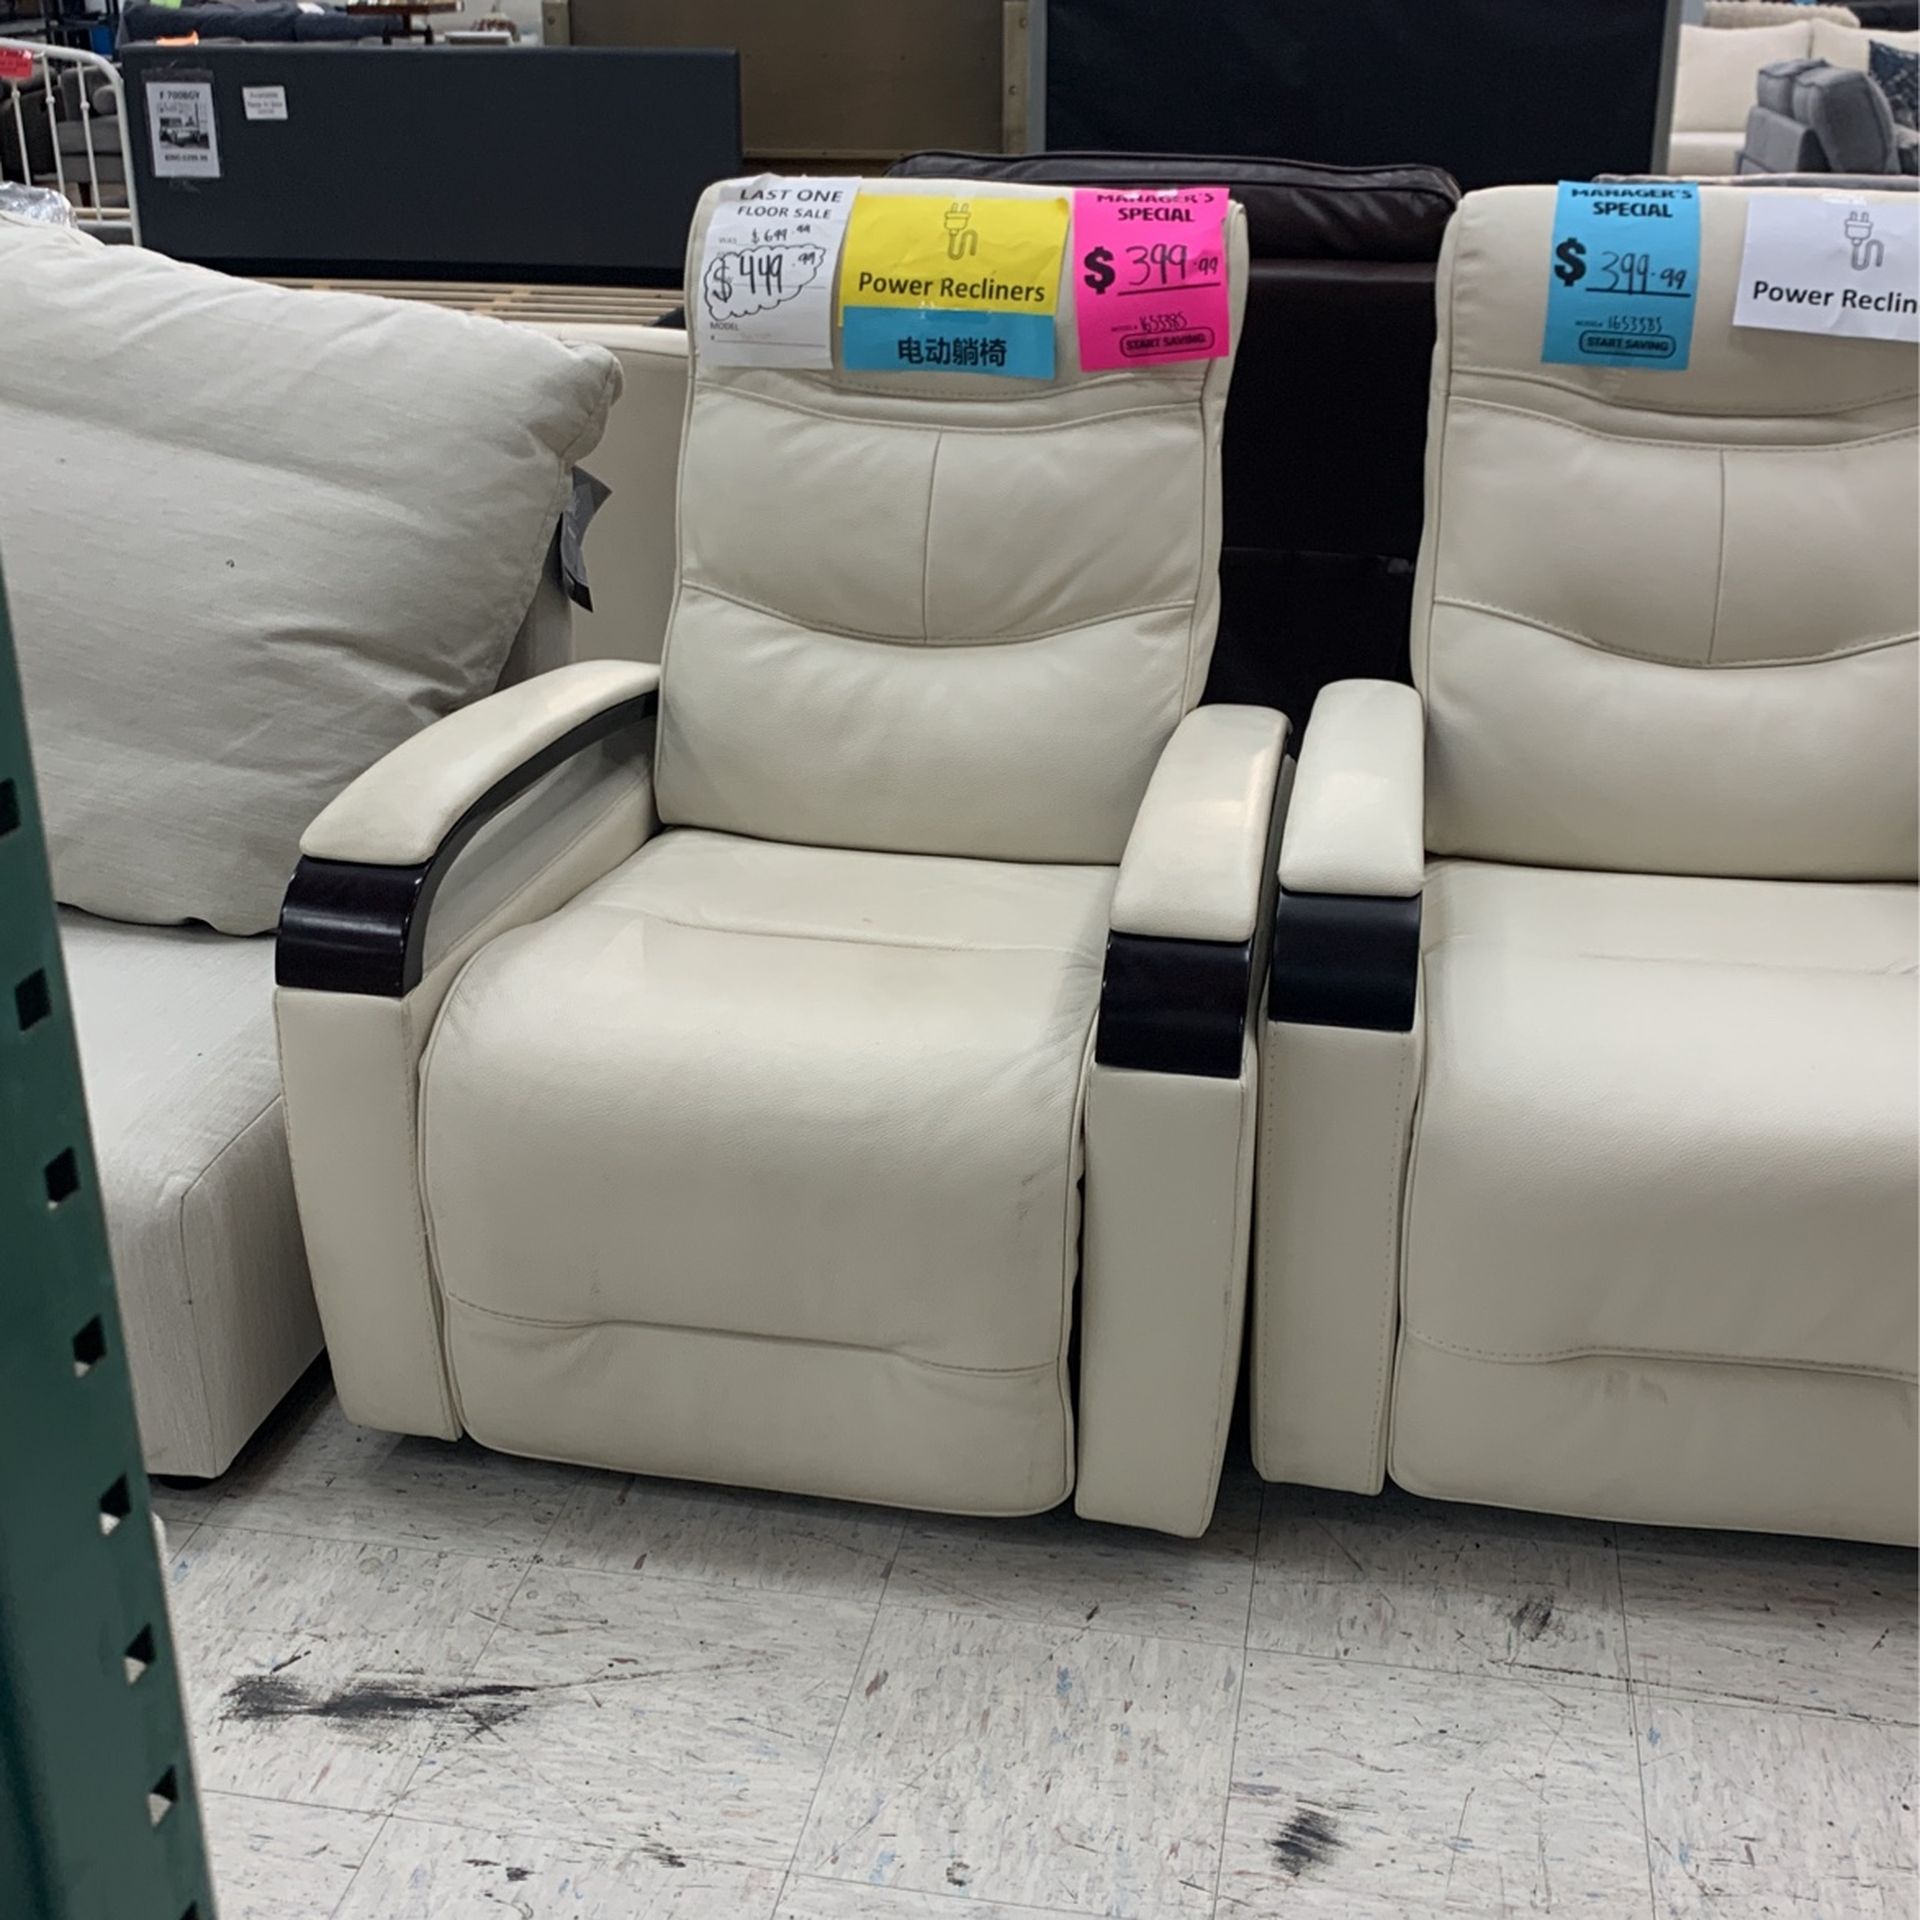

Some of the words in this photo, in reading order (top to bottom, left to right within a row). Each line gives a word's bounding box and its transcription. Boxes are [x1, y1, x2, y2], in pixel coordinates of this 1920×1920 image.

[739, 188, 795, 202] LAST
[796, 188, 844, 204] ONE
[1097, 193, 1215, 203] MANAGR'S
[1571, 188, 1693, 199] MANAGER'S
[737, 206, 789, 219] FLOOR
[793, 207, 832, 220] SALE
[1117, 207, 1195, 222] SPECIAL
[1592, 201, 1674, 218] SPECIAL
[1083, 246, 1116, 295] $
[1553, 237, 1587, 287] $
[858, 272, 934, 297] Power
[939, 277, 1046, 302] Recliners
[1752, 280, 1835, 307] Power
[1841, 289, 1919, 315] Reclin
[1126, 336, 1161, 350] START
[1163, 333, 1207, 346] SAVING
[1586, 336, 1623, 349] START
[1625, 339, 1670, 351] SAVING
[898, 336, 1007, 367] 电动躺椅
